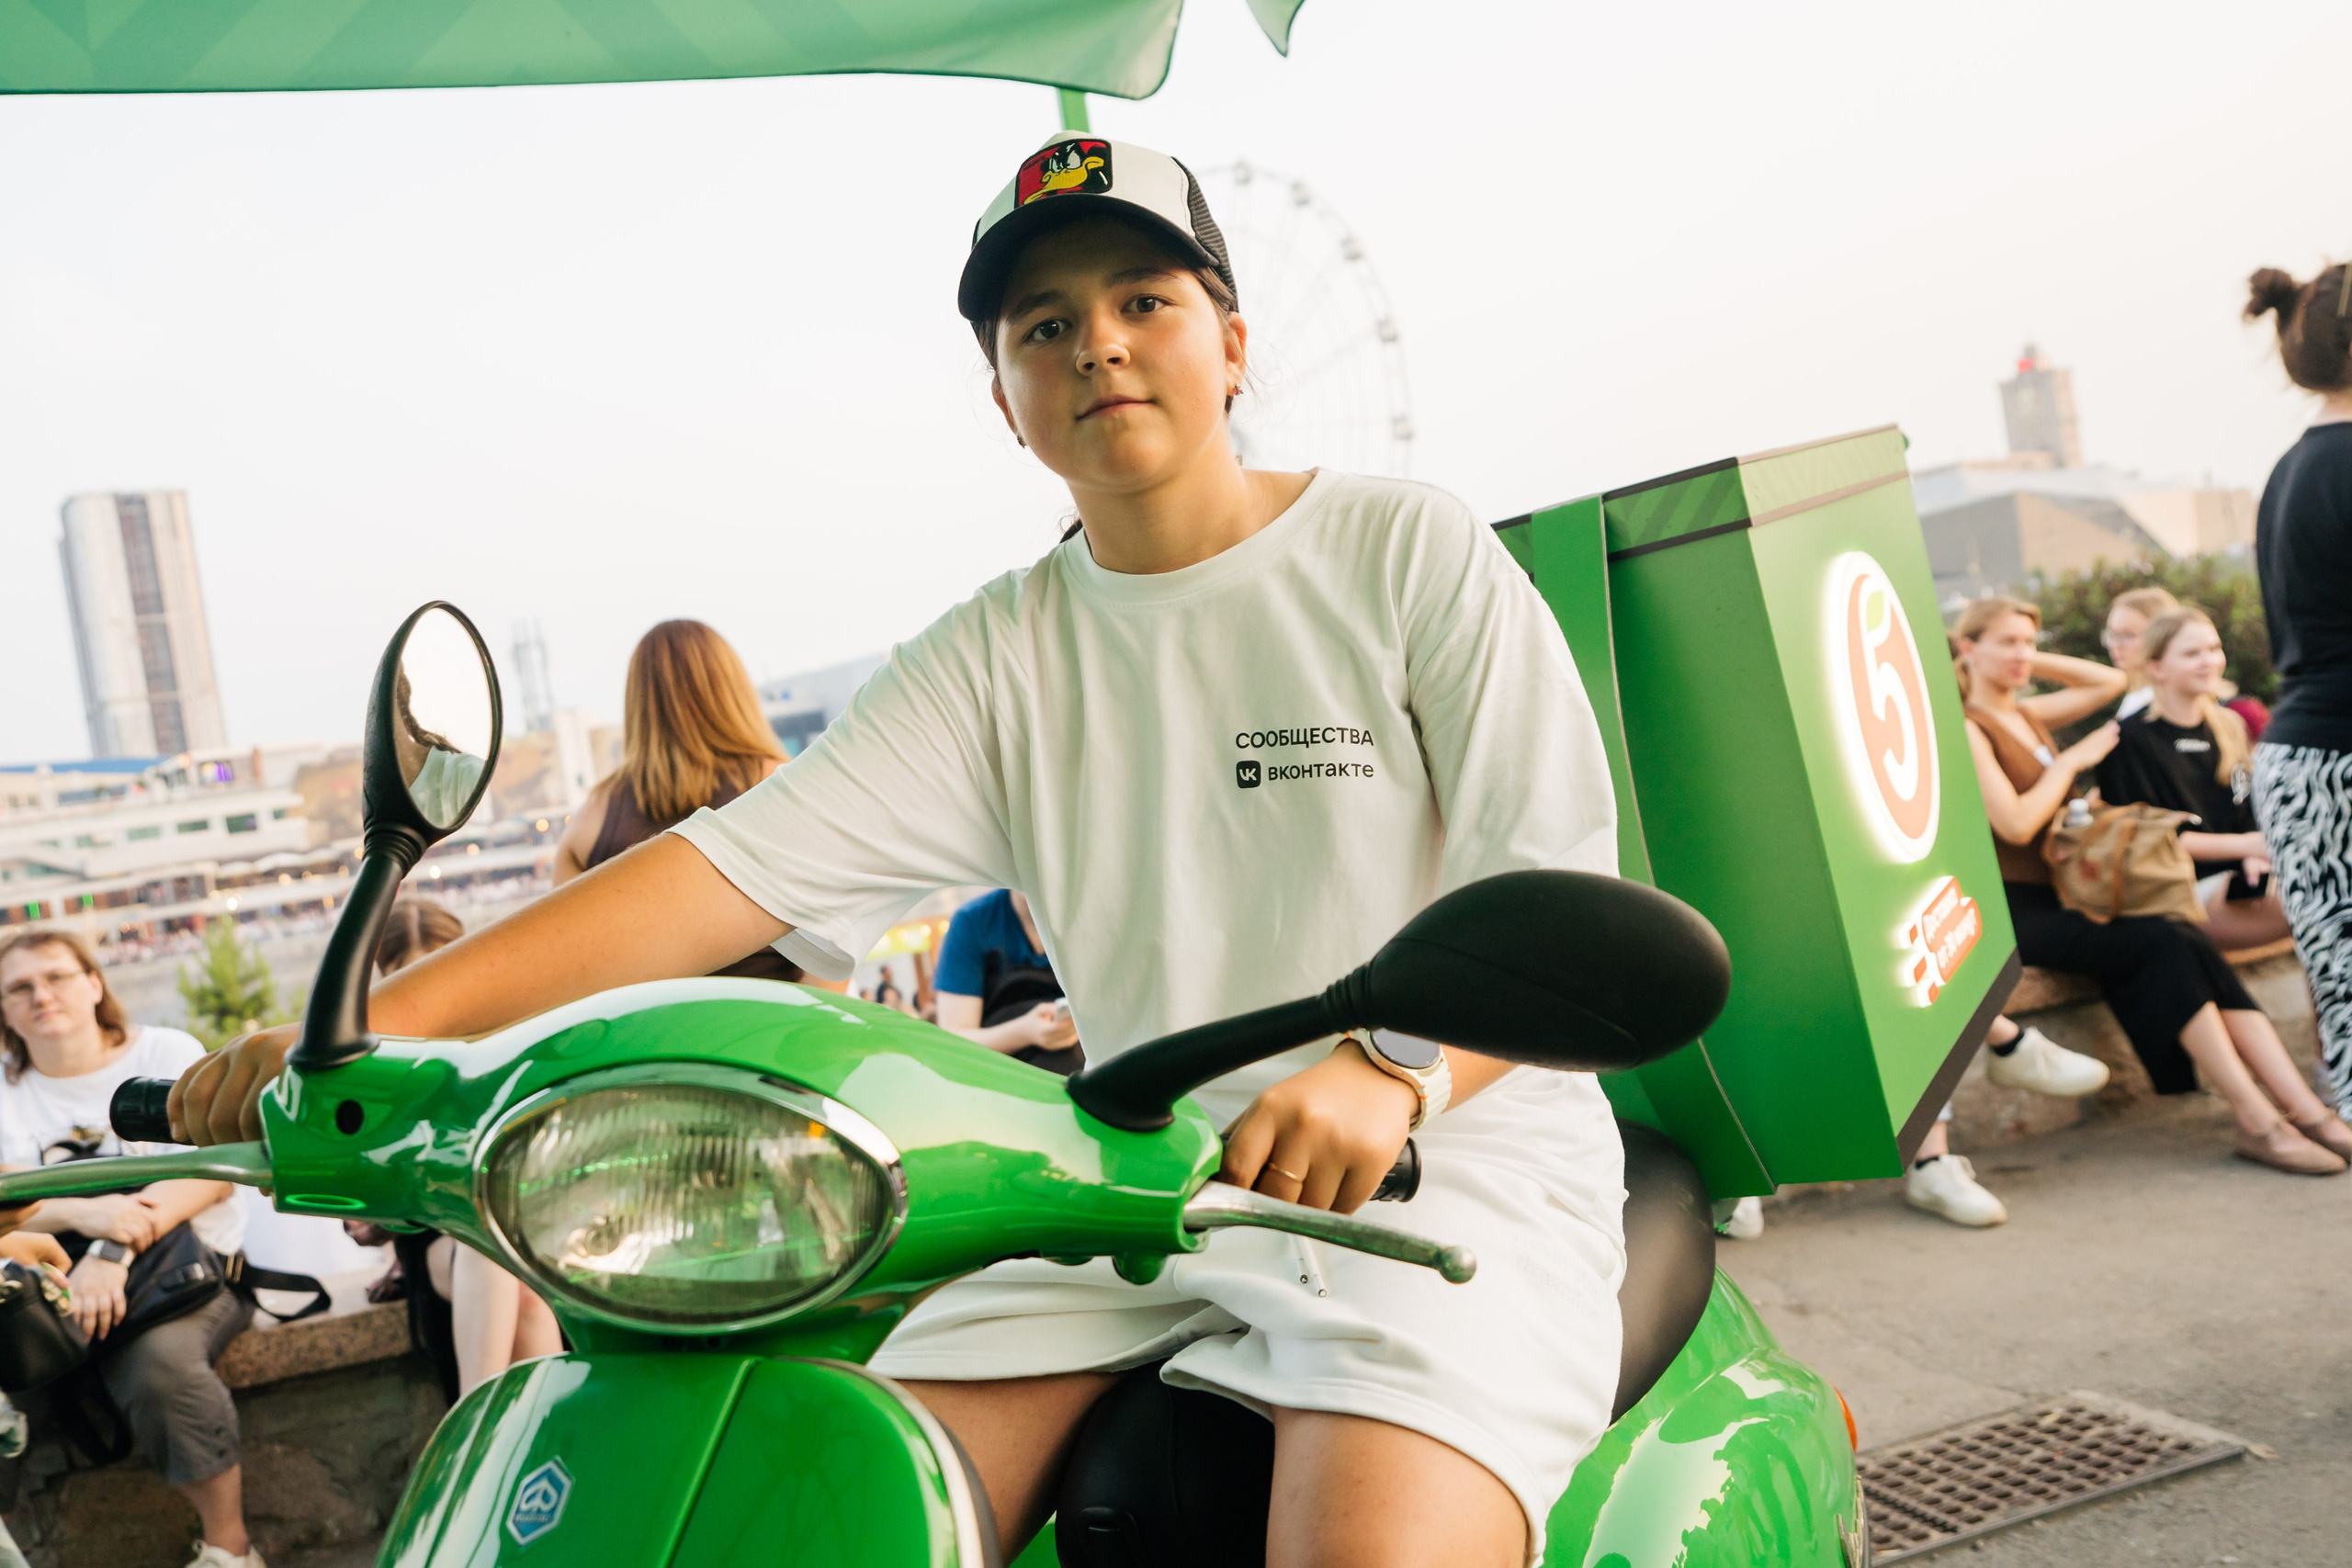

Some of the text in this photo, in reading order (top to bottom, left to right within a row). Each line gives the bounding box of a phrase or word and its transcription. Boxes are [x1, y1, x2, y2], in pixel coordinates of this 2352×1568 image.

[1858, 575, 1919, 802] 5
[1236, 727, 1374, 749] СООБЩЕСТВА
[1268, 762, 1374, 781] вконтакте
